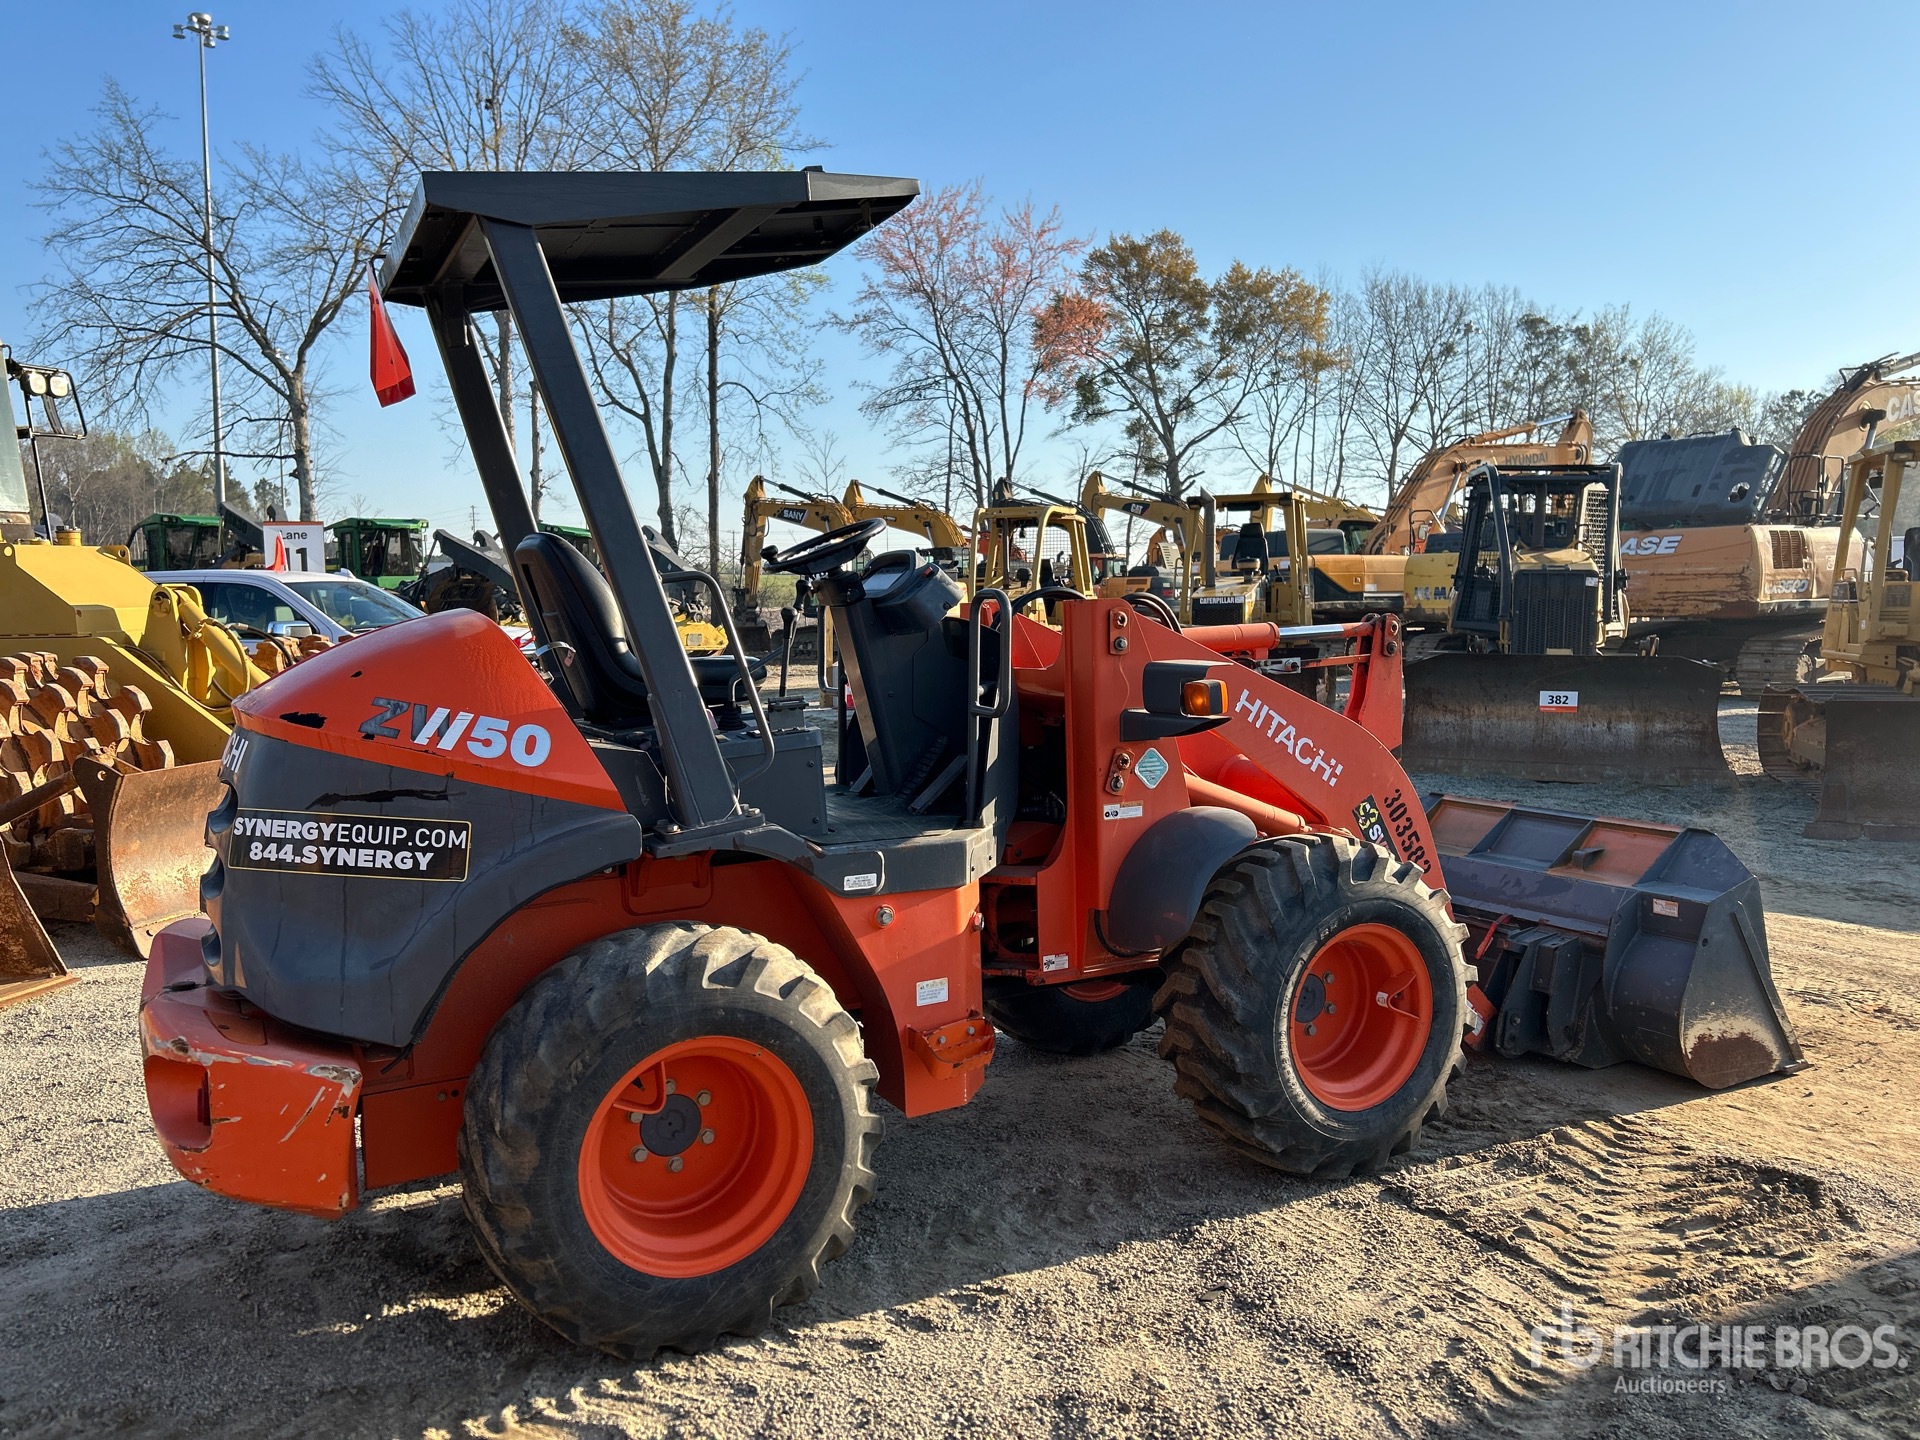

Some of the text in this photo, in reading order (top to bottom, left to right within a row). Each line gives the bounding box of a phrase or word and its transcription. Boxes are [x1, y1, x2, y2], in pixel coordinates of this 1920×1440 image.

[1505, 450, 1549, 466] HYUNDAI
[783, 509, 804, 520] SANY
[1130, 503, 1144, 514] CAT
[1199, 597, 1235, 605] CATERPILLAR
[1547, 695, 1569, 705] 382
[1235, 688, 1344, 787] HITACHI
[234, 816, 467, 849] SYNERGYEQUIP.COM
[250, 841, 434, 871] 844.SYNERGY
